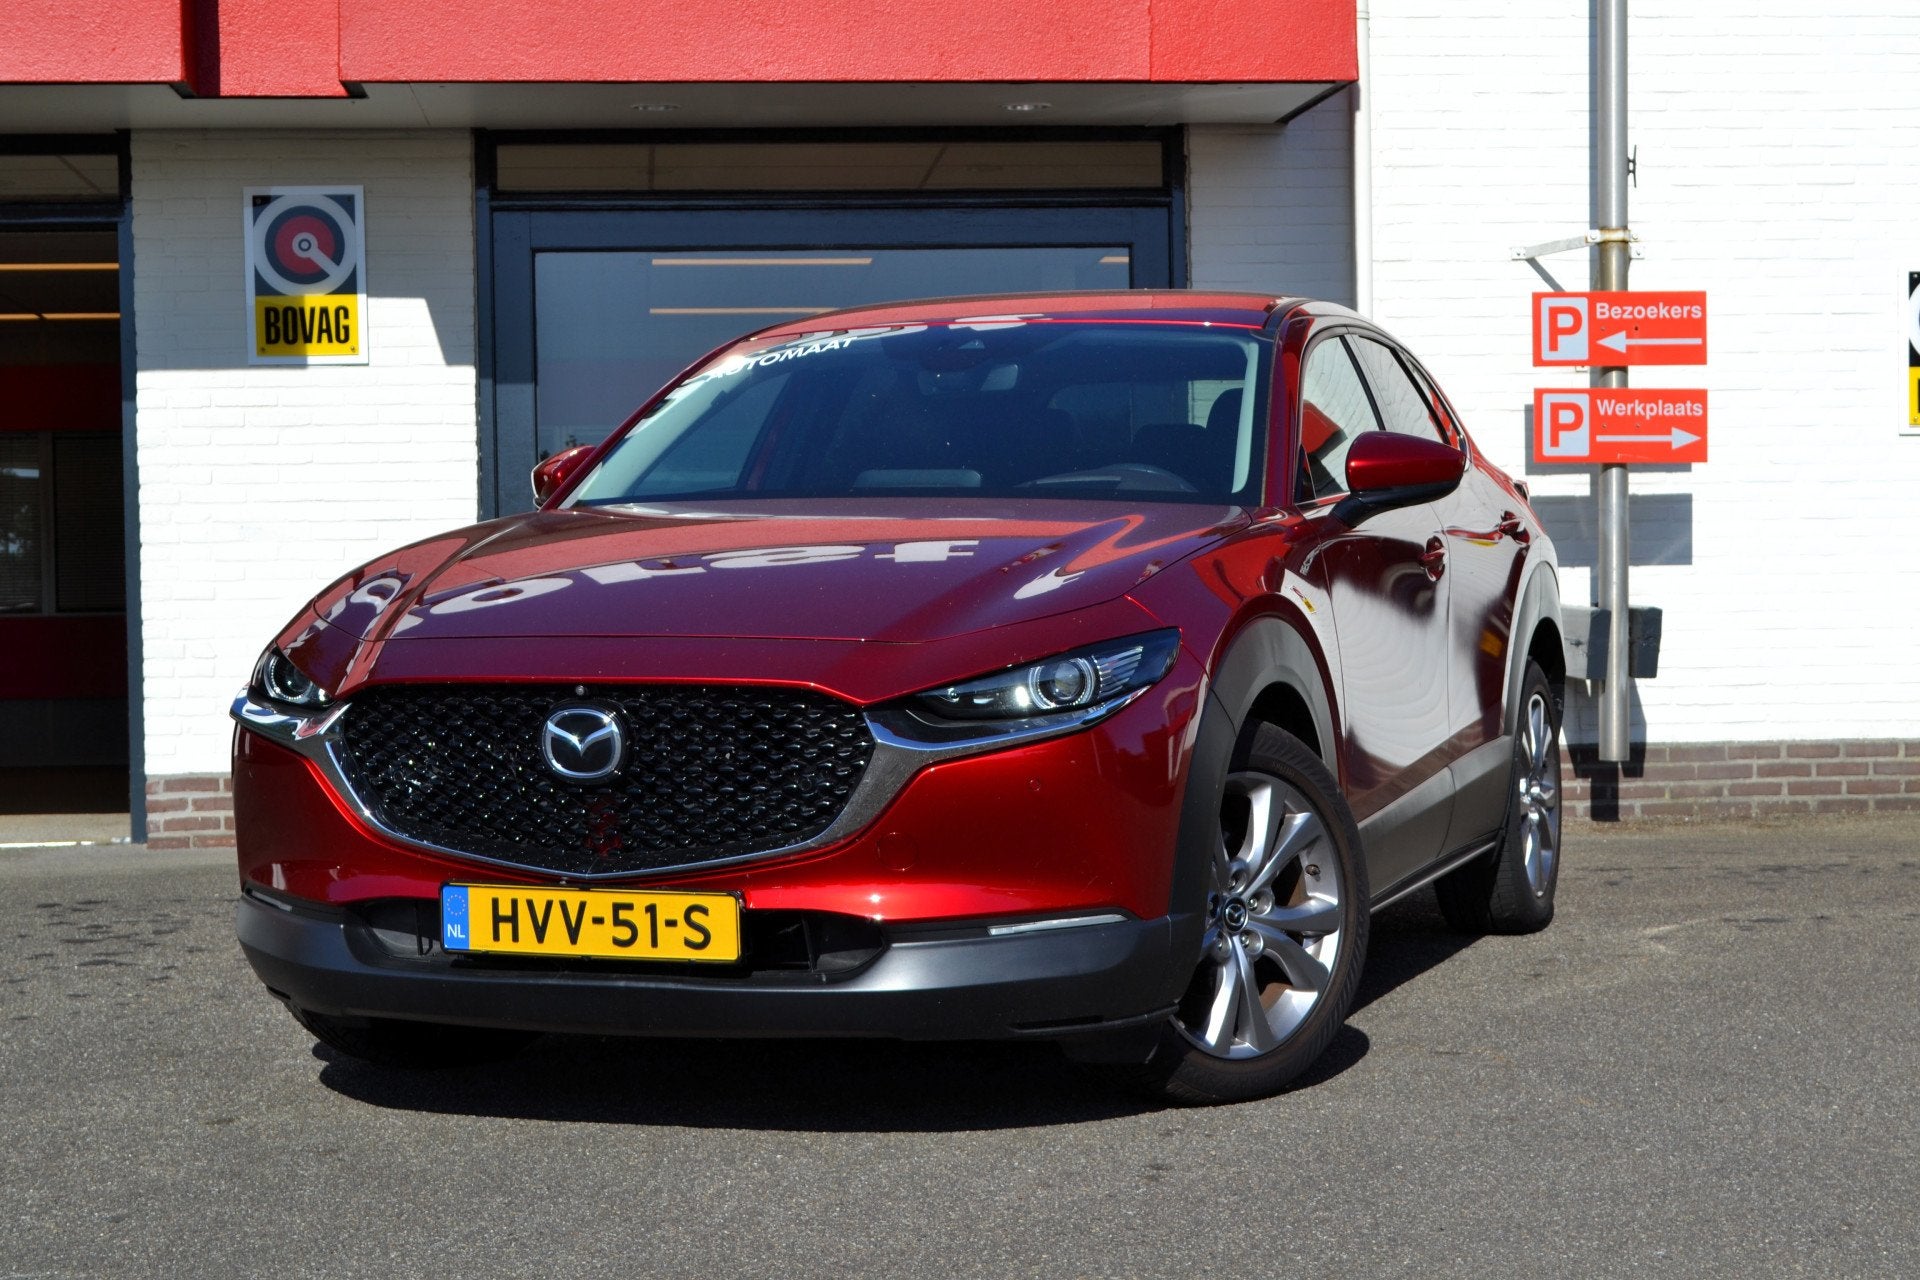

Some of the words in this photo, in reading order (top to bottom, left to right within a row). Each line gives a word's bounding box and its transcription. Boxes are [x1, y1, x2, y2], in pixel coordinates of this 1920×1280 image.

[264, 305, 350, 345] BOVAG
[1549, 306, 1583, 352] P
[1596, 302, 1702, 319] Bezoekers
[1550, 402, 1584, 448] P
[1597, 399, 1703, 420] Werkplaats
[447, 923, 466, 939] NL
[491, 897, 712, 951] HVV-51-S
